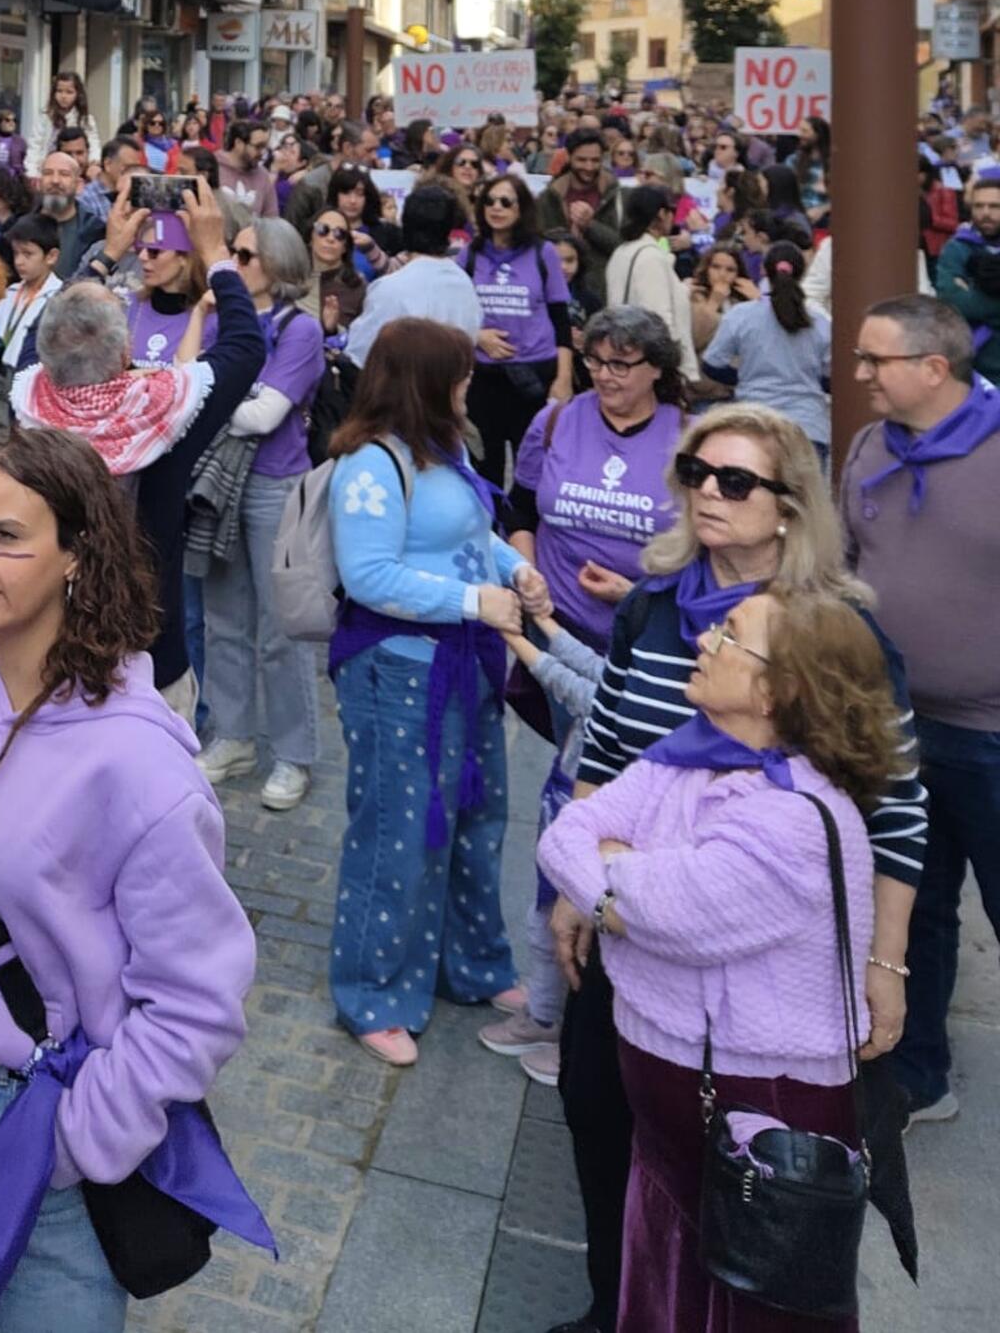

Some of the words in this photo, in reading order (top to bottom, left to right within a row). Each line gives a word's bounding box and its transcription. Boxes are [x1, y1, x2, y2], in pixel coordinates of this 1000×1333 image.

[401, 62, 446, 94] NO
[745, 56, 797, 89] NO
[560, 482, 654, 511] FEMINISMO
[554, 499, 655, 532] INVENCIBLE
